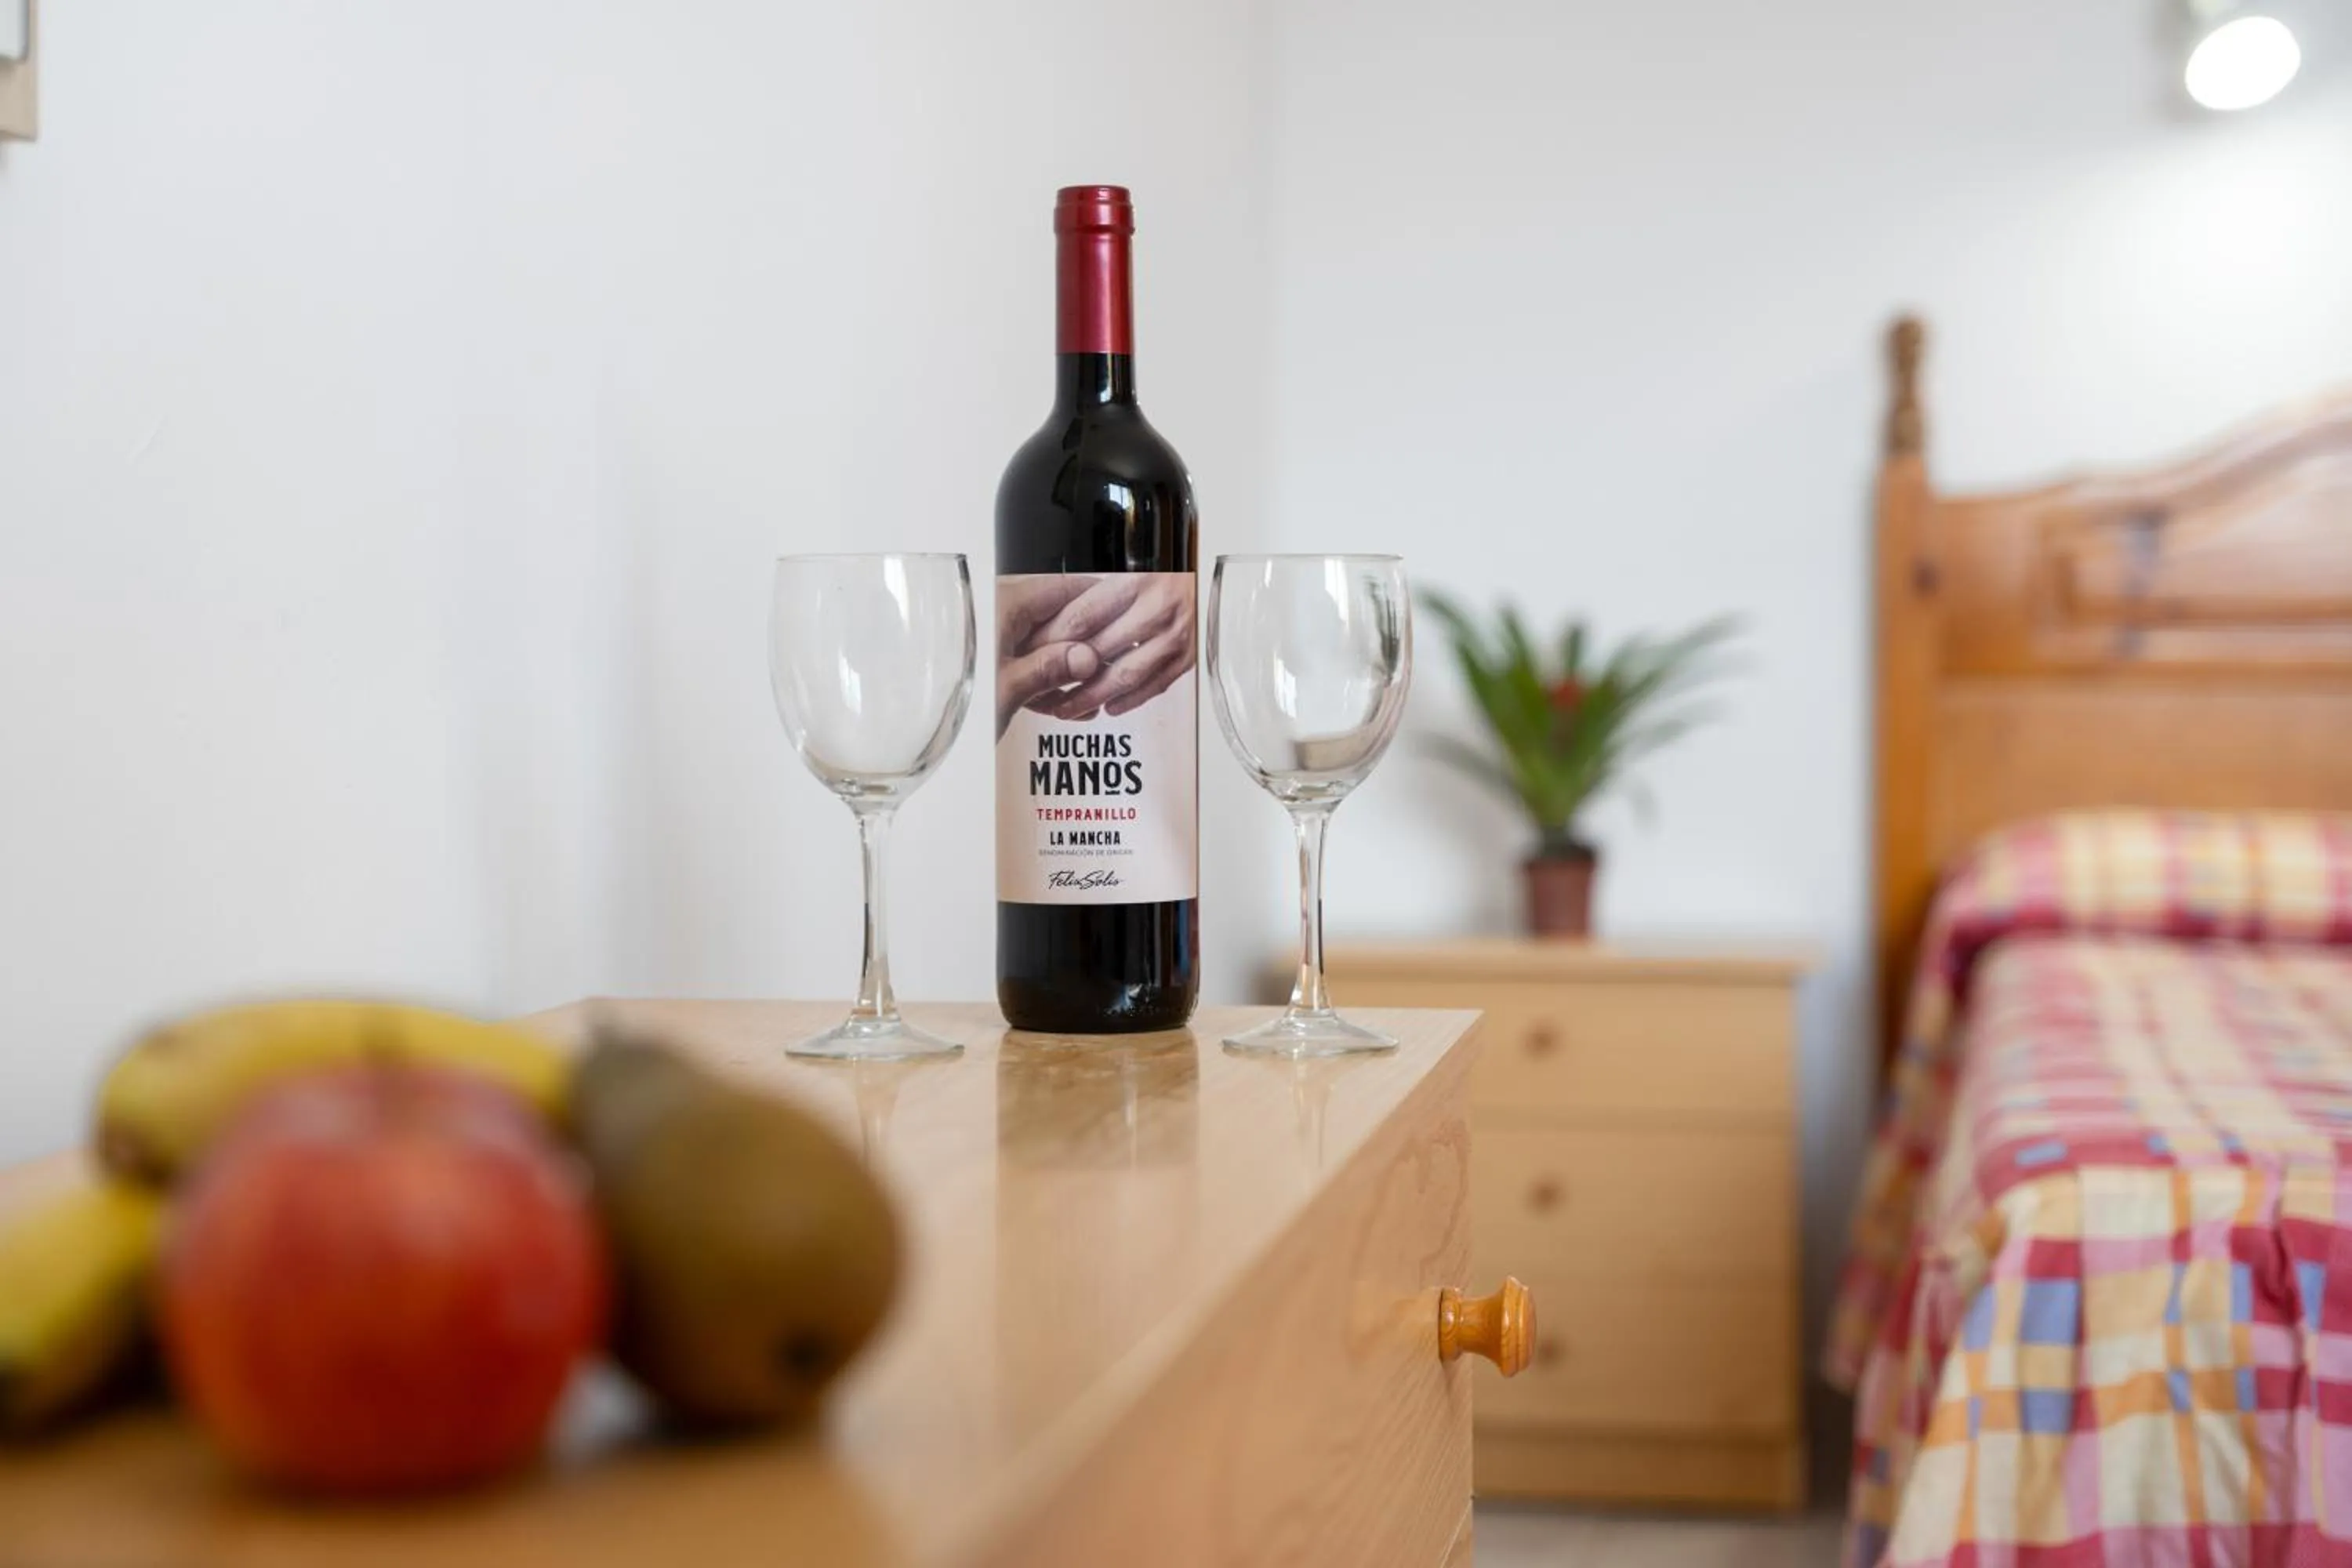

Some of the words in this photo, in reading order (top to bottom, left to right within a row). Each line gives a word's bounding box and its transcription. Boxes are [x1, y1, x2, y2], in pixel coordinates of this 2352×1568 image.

[1038, 734, 1131, 758] MUCHAS
[1029, 760, 1142, 796] MANOS
[1036, 808, 1137, 821] TEMPRANILLO
[1050, 831, 1065, 845] LA
[1069, 831, 1121, 845] MANCHA
